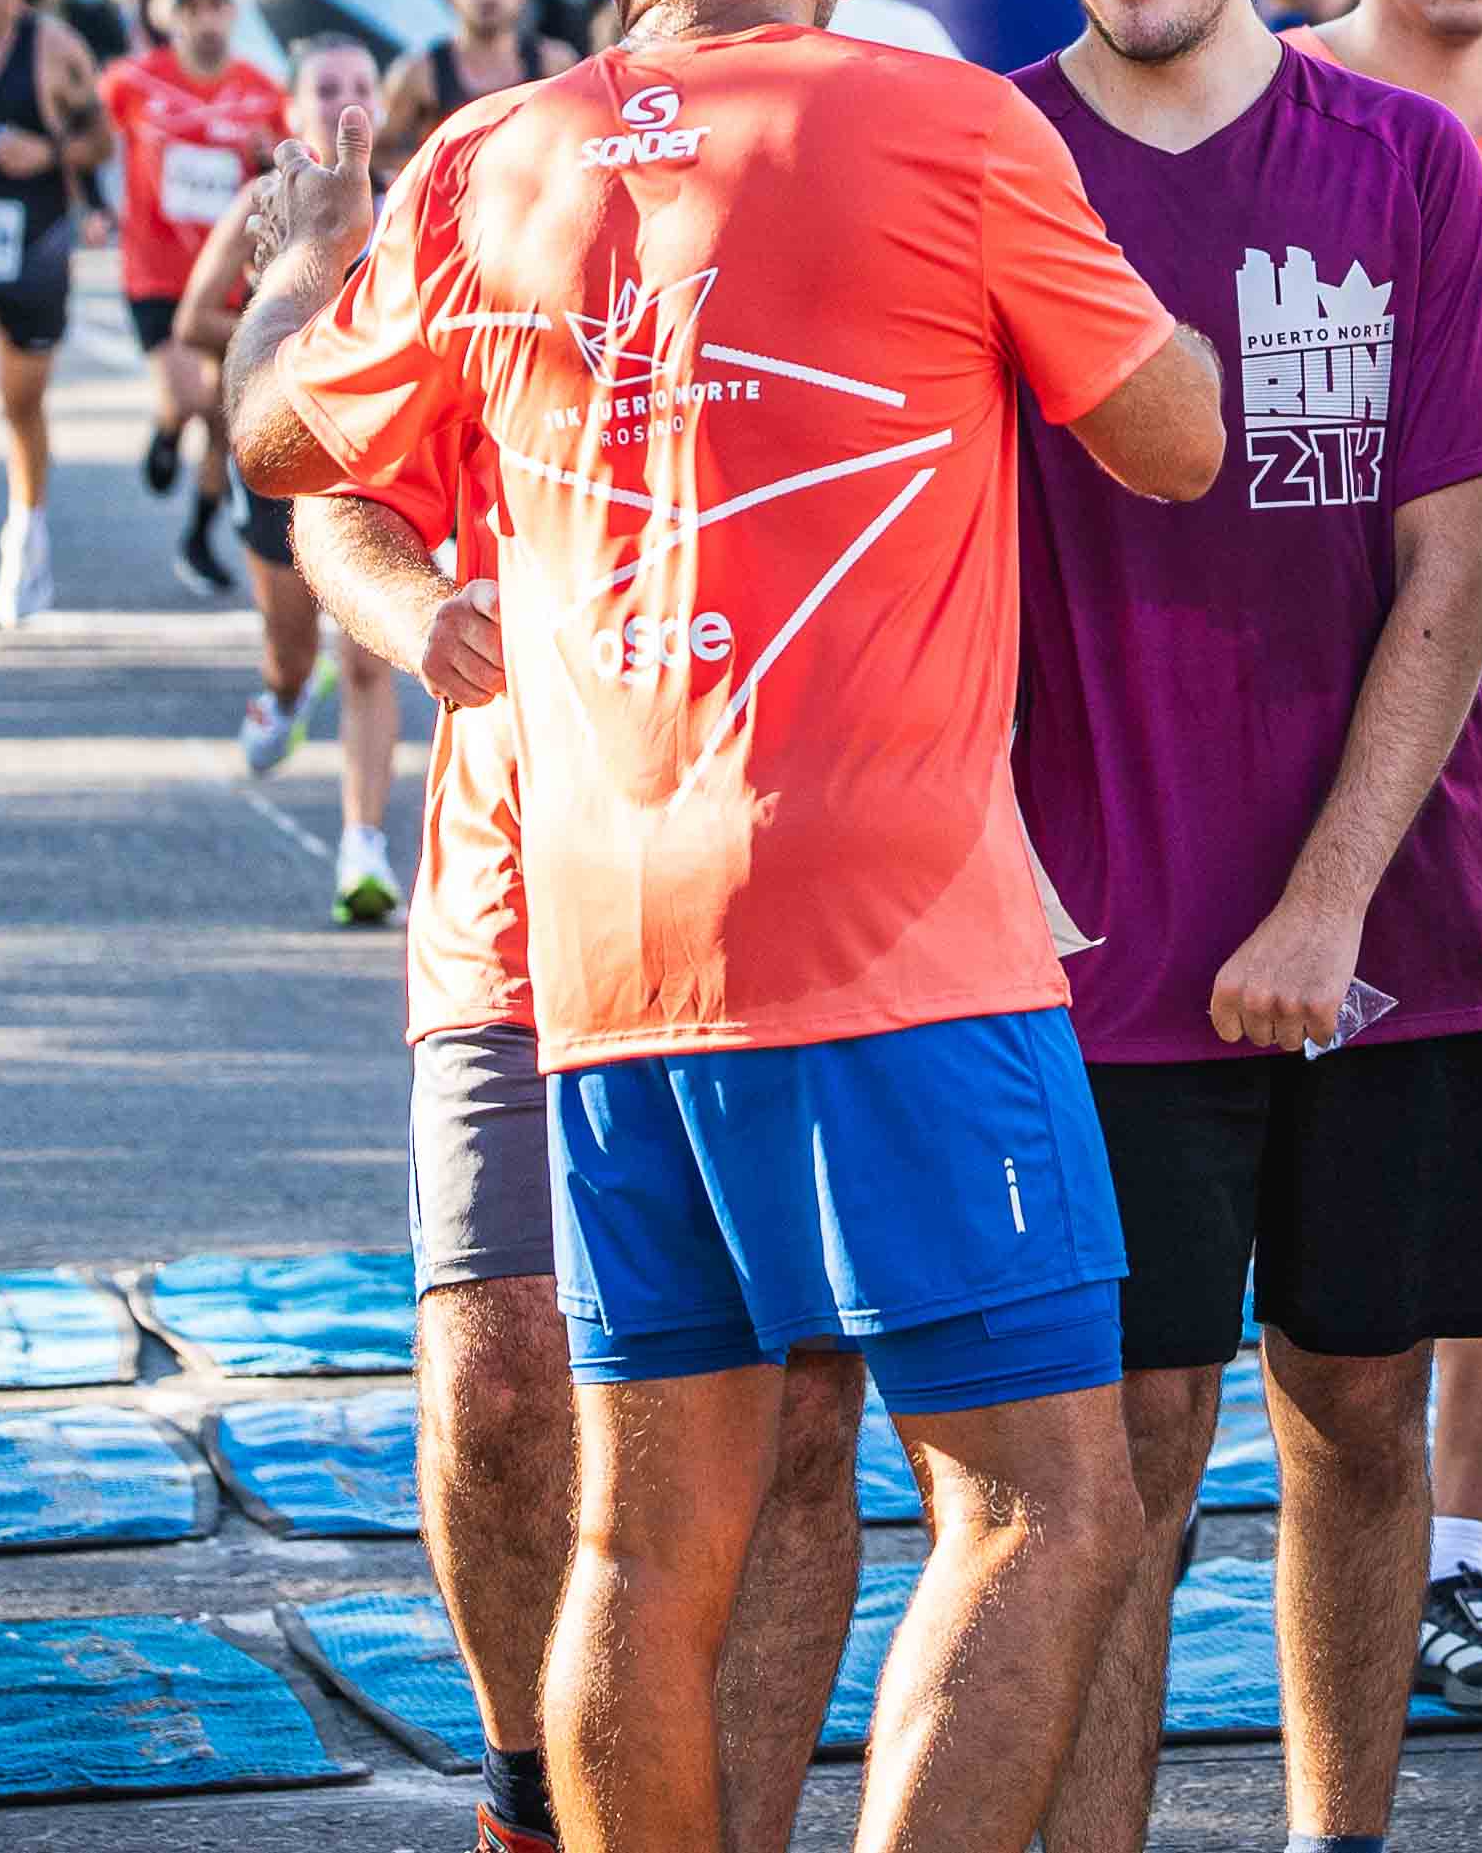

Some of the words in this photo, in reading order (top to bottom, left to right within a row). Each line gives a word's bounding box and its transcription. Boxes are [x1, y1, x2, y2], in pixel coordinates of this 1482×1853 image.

[1248, 328, 1329, 349] PUERTO
[1338, 323, 1391, 340] NORTE
[588, 388, 668, 422] UERTO
[674, 379, 761, 405] NORTE
[1242, 343, 1392, 421] RUN
[599, 415, 685, 447] ROSRO
[1246, 427, 1386, 509] 21K
